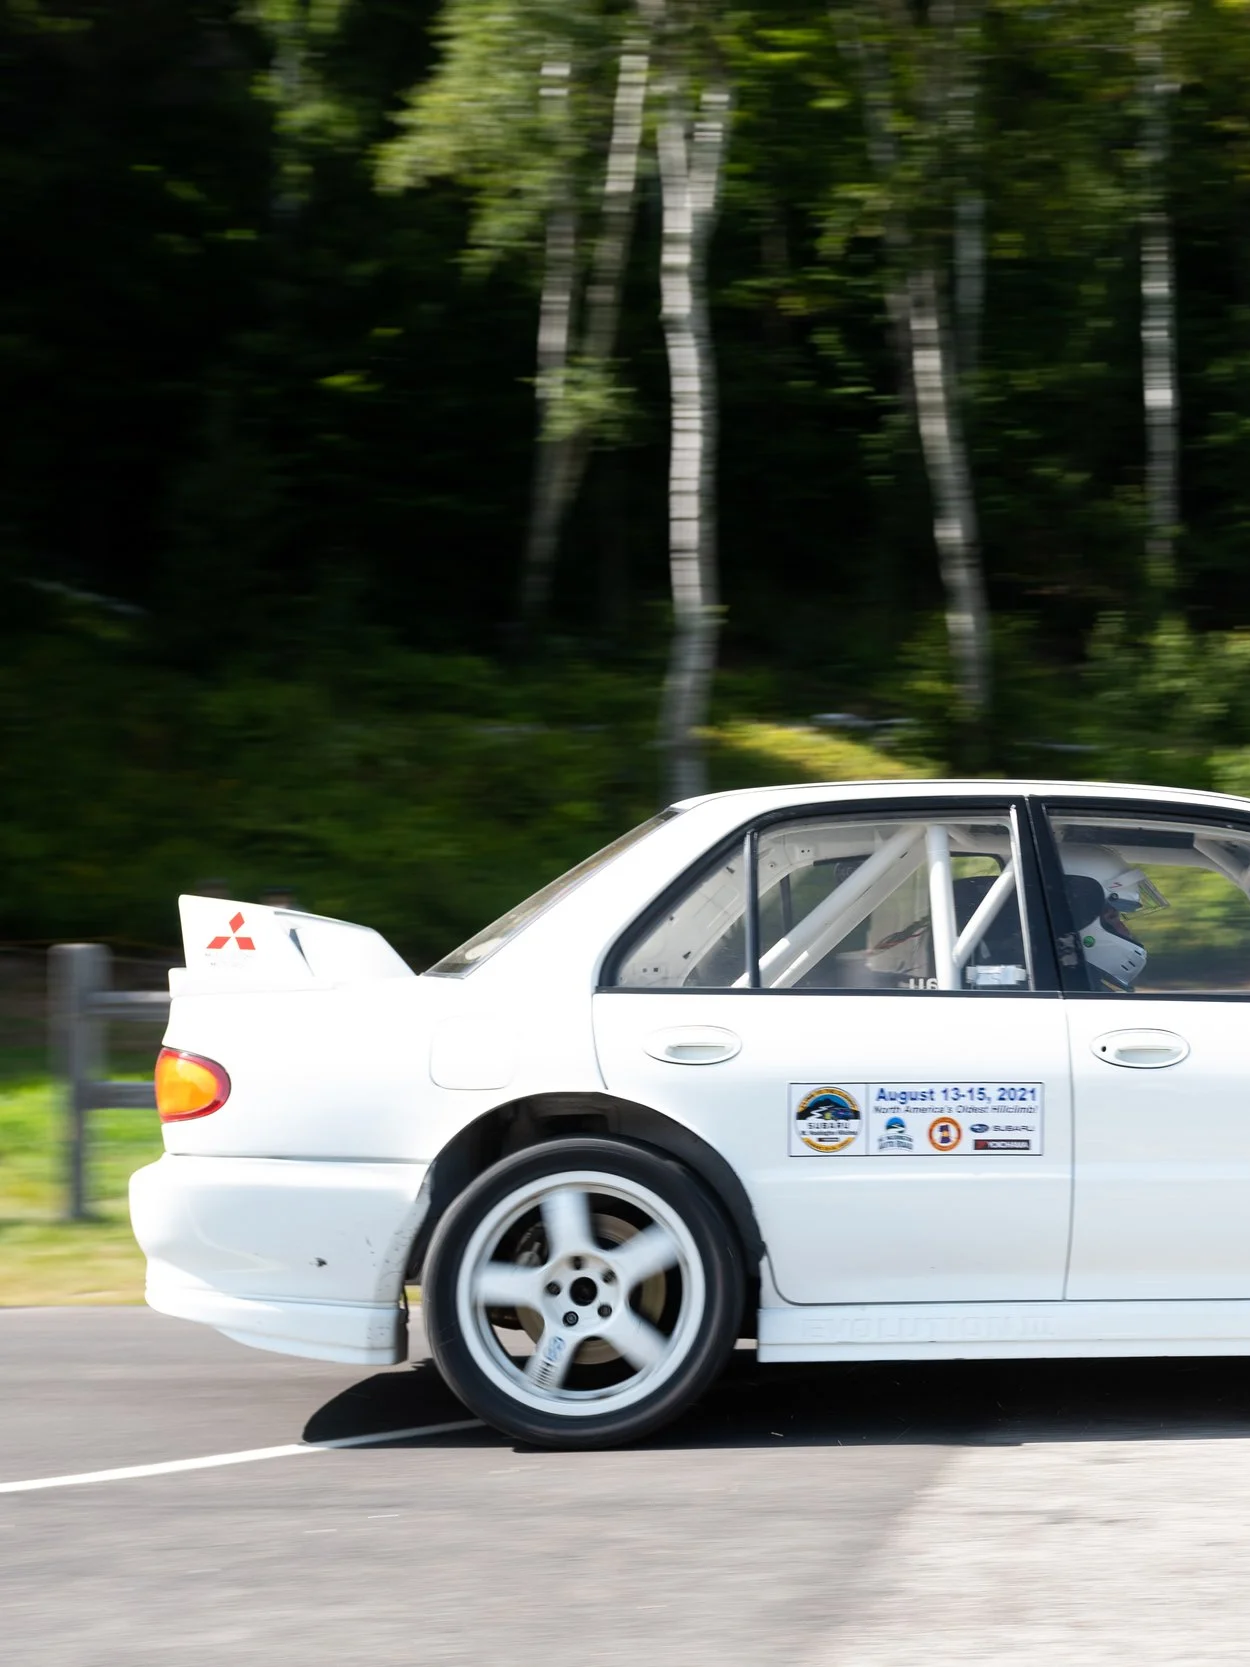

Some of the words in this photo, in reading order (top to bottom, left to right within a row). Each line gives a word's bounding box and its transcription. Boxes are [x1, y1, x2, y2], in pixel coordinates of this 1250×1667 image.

[876, 1087, 935, 1105] August
[941, 1087, 992, 1104] 13-15,
[997, 1087, 1037, 1101] 2021
[873, 1105, 901, 1113] North
[904, 1105, 953, 1113] America's
[956, 1104, 989, 1113] Oldest
